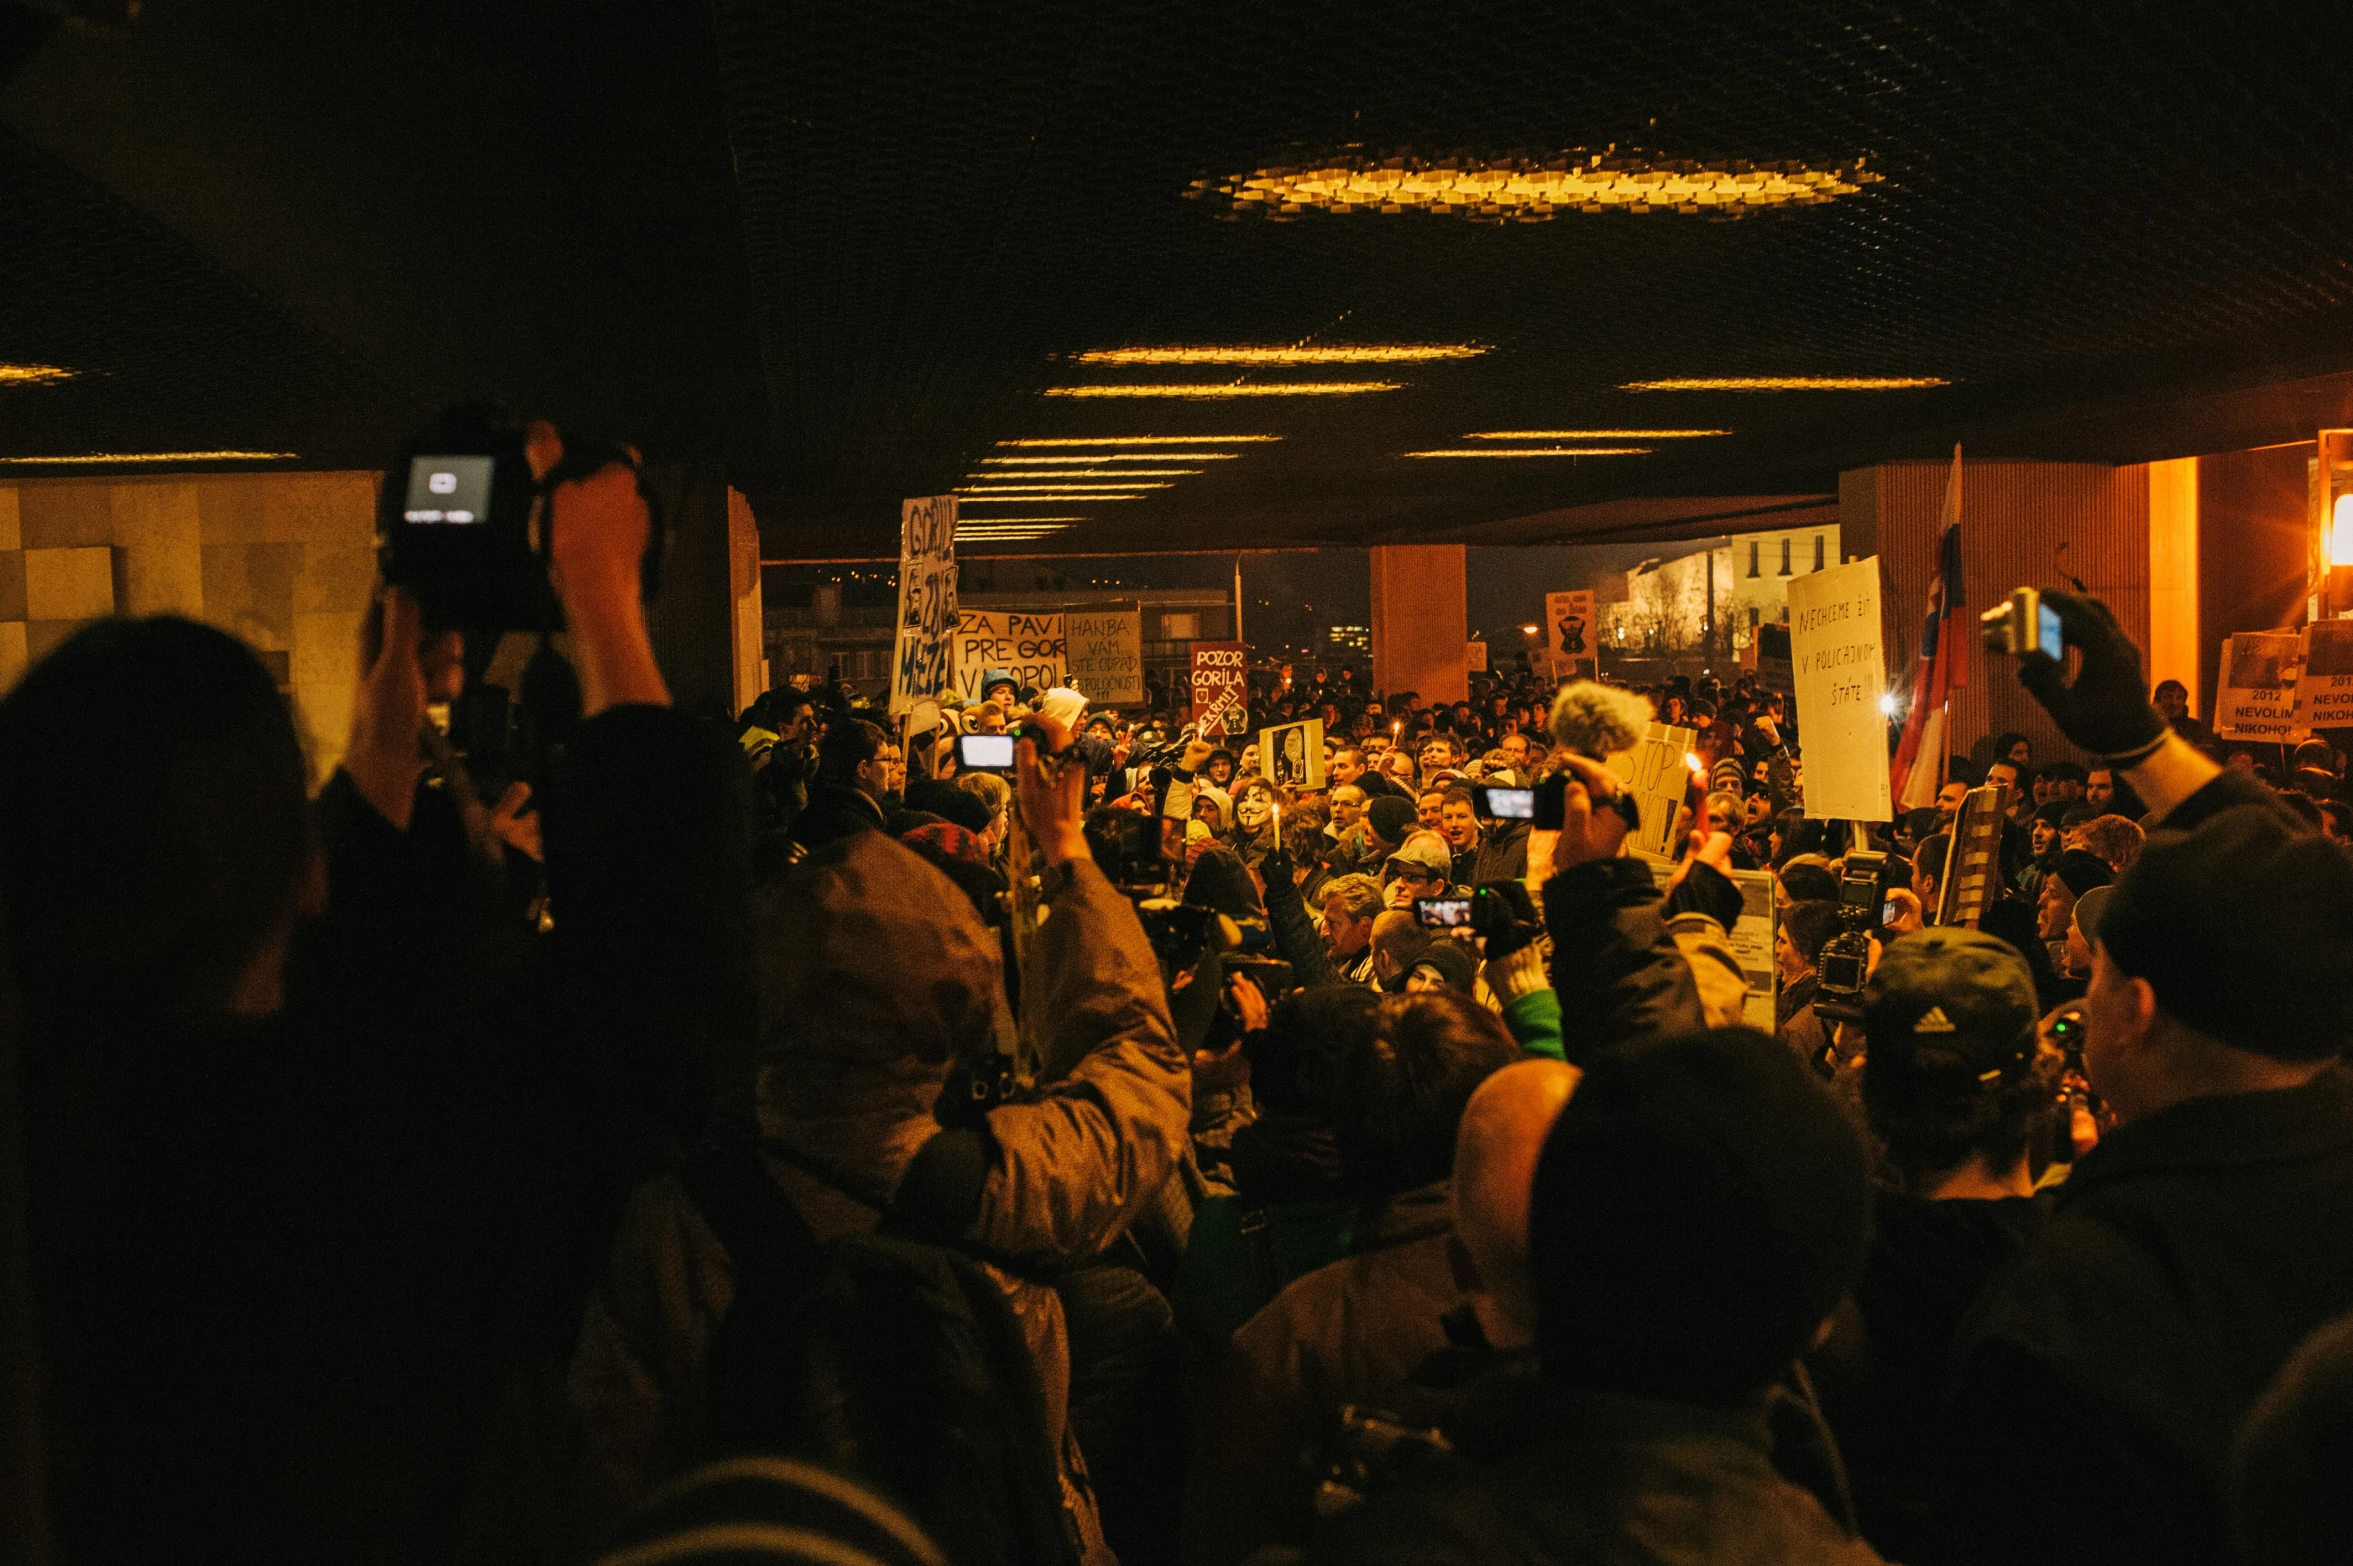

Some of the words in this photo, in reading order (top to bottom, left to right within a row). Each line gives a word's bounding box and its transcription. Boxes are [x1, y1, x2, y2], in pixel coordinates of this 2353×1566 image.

[957, 614, 995, 635] ZA
[1008, 615, 1062, 636] PAVI
[1072, 619, 1130, 637] HANBA
[1799, 602, 1849, 636] NECHCEME
[965, 638, 1013, 663] PRE
[1196, 650, 1243, 667] POZOR
[1072, 658, 1095, 673] STE
[1098, 656, 1137, 672] ODPAD
[1802, 655, 1809, 674] V
[960, 668, 977, 698] V
[1191, 668, 1245, 687] GORILA
[2252, 690, 2281, 701] 2012
[2234, 722, 2292, 735] NIKOHO!
